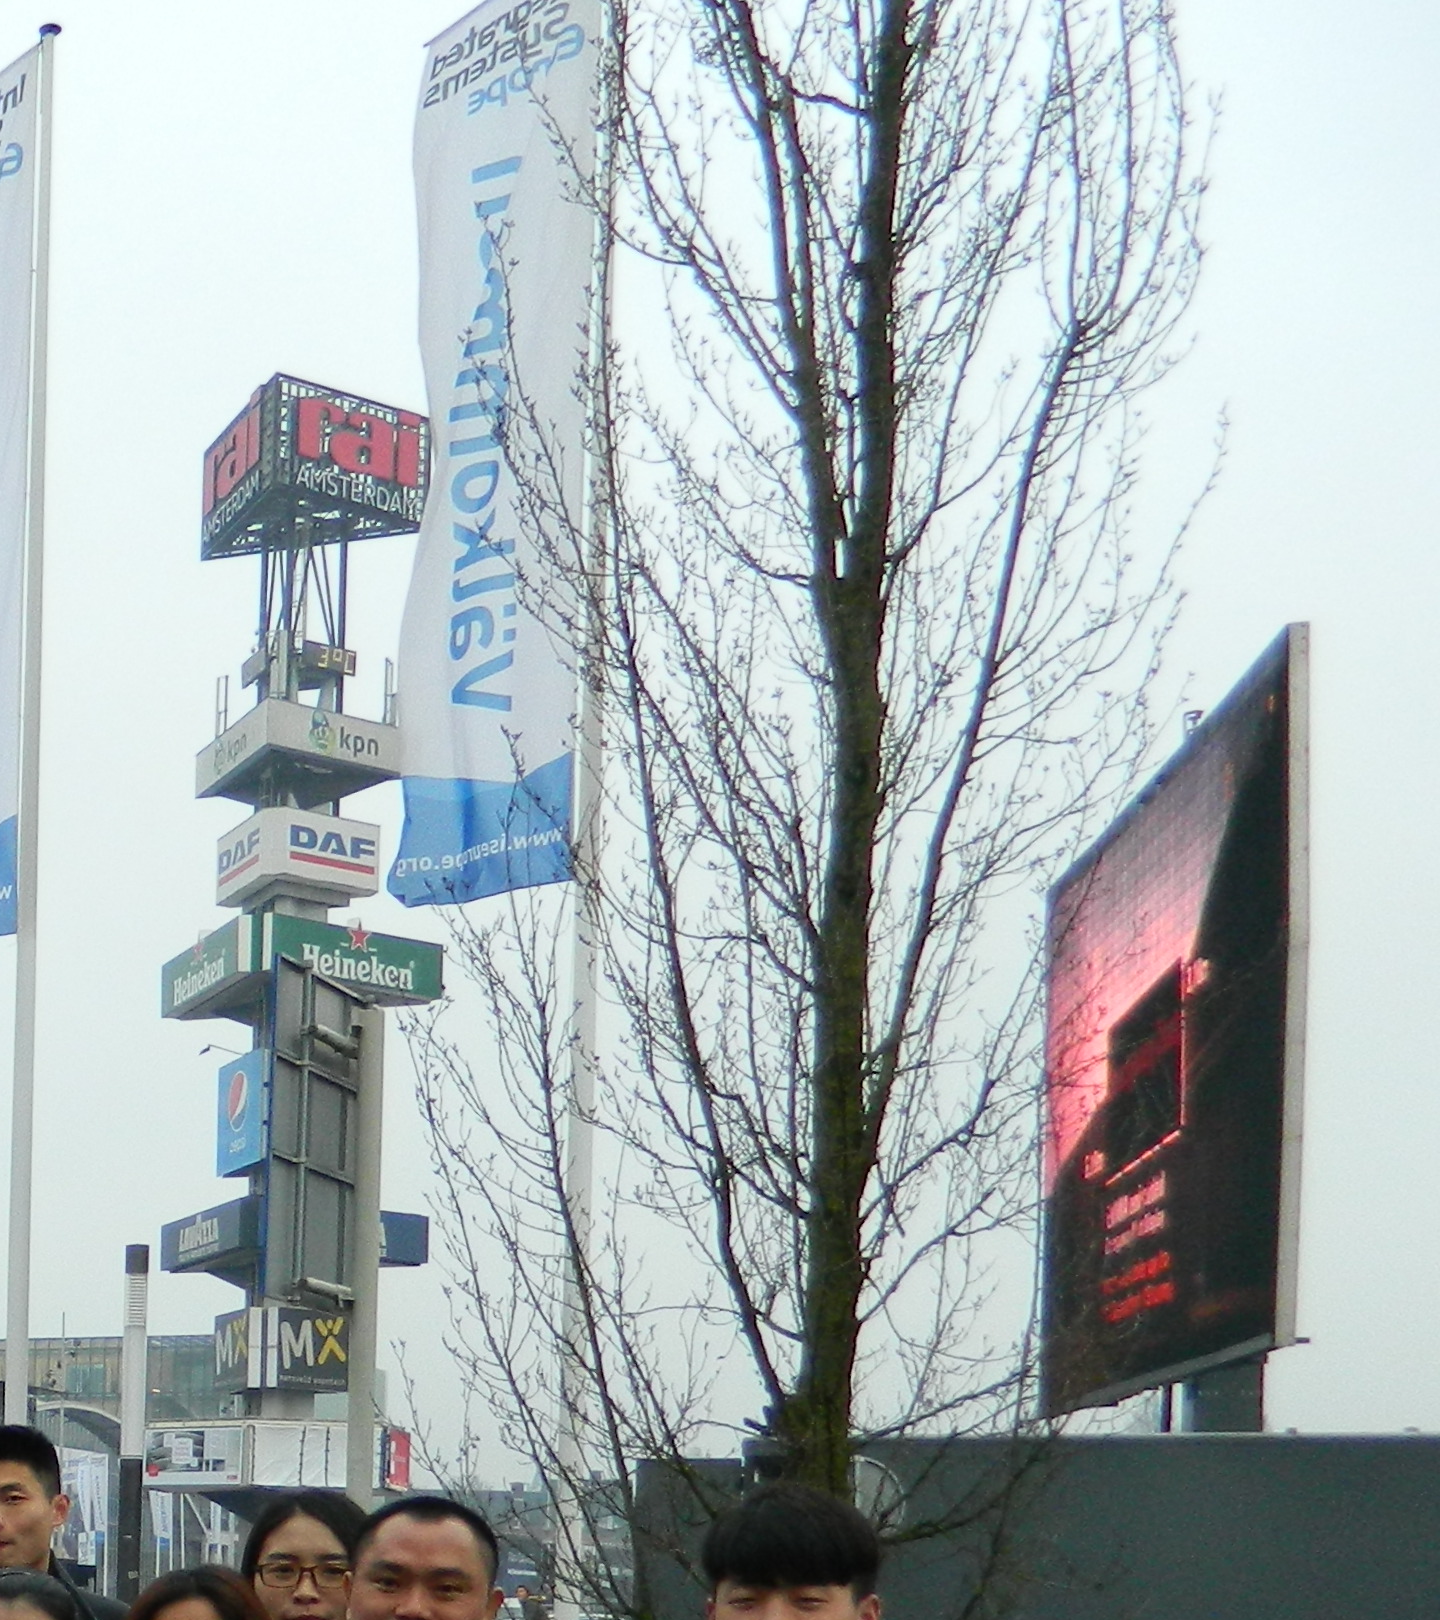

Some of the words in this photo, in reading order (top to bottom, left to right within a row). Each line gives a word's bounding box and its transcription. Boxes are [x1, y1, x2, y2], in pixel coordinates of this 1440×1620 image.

[203, 385, 261, 516] rai
[297, 398, 419, 488] rai
[203, 469, 260, 542] AMSTERDAM
[296, 464, 420, 520] AMSTERDAM
[339, 727, 379, 758] kpn
[219, 827, 260, 875] DAF
[290, 824, 376, 859] DAF
[173, 954, 225, 1007] Heineken
[302, 943, 414, 991] Heineken
